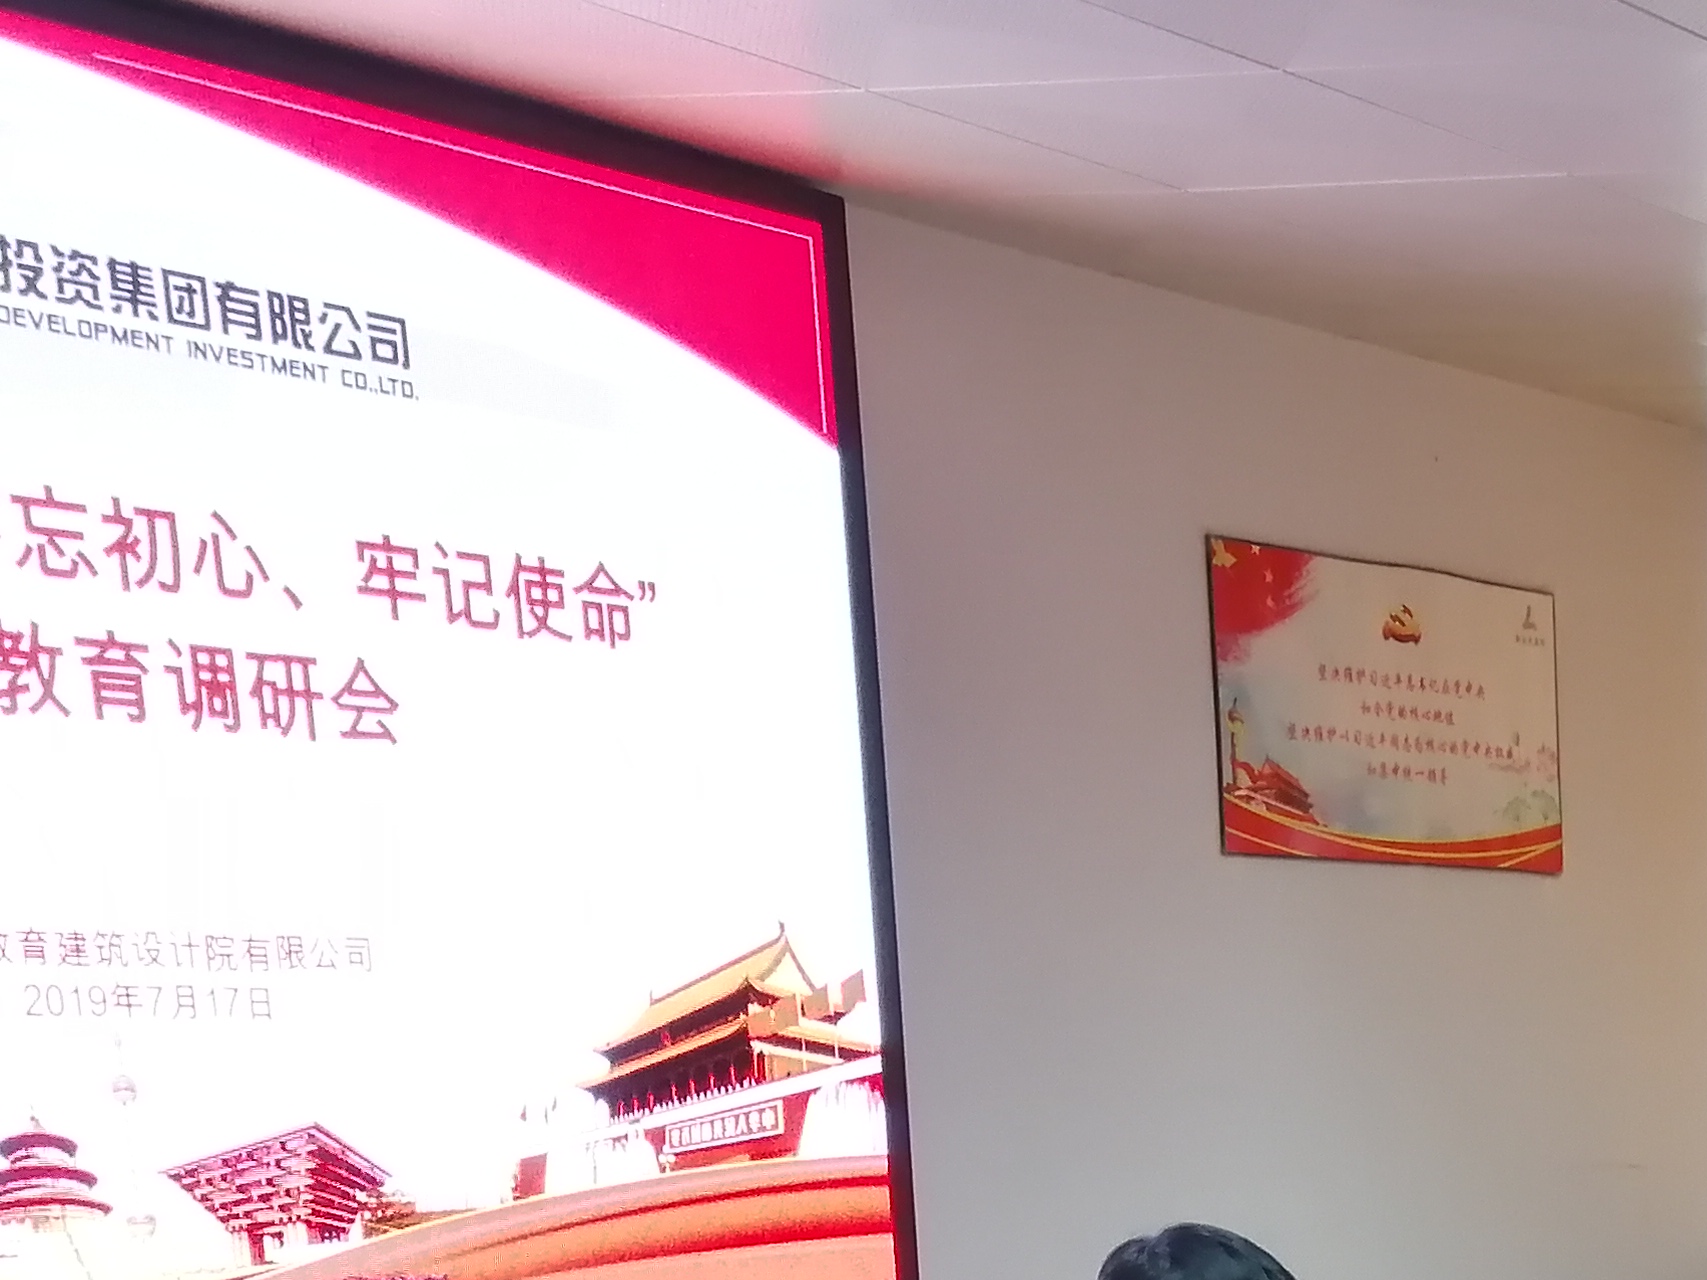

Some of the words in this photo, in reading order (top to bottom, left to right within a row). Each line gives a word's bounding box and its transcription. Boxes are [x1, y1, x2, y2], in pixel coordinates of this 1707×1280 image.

[0, 234, 410, 370] 投资集团有限公司
[0, 304, 174, 355] DEVELOPMENT
[186, 339, 329, 385] INVESTMENT
[0, 620, 400, 745] 教育调研会
[24, 982, 271, 1020] 2019年7月17日
